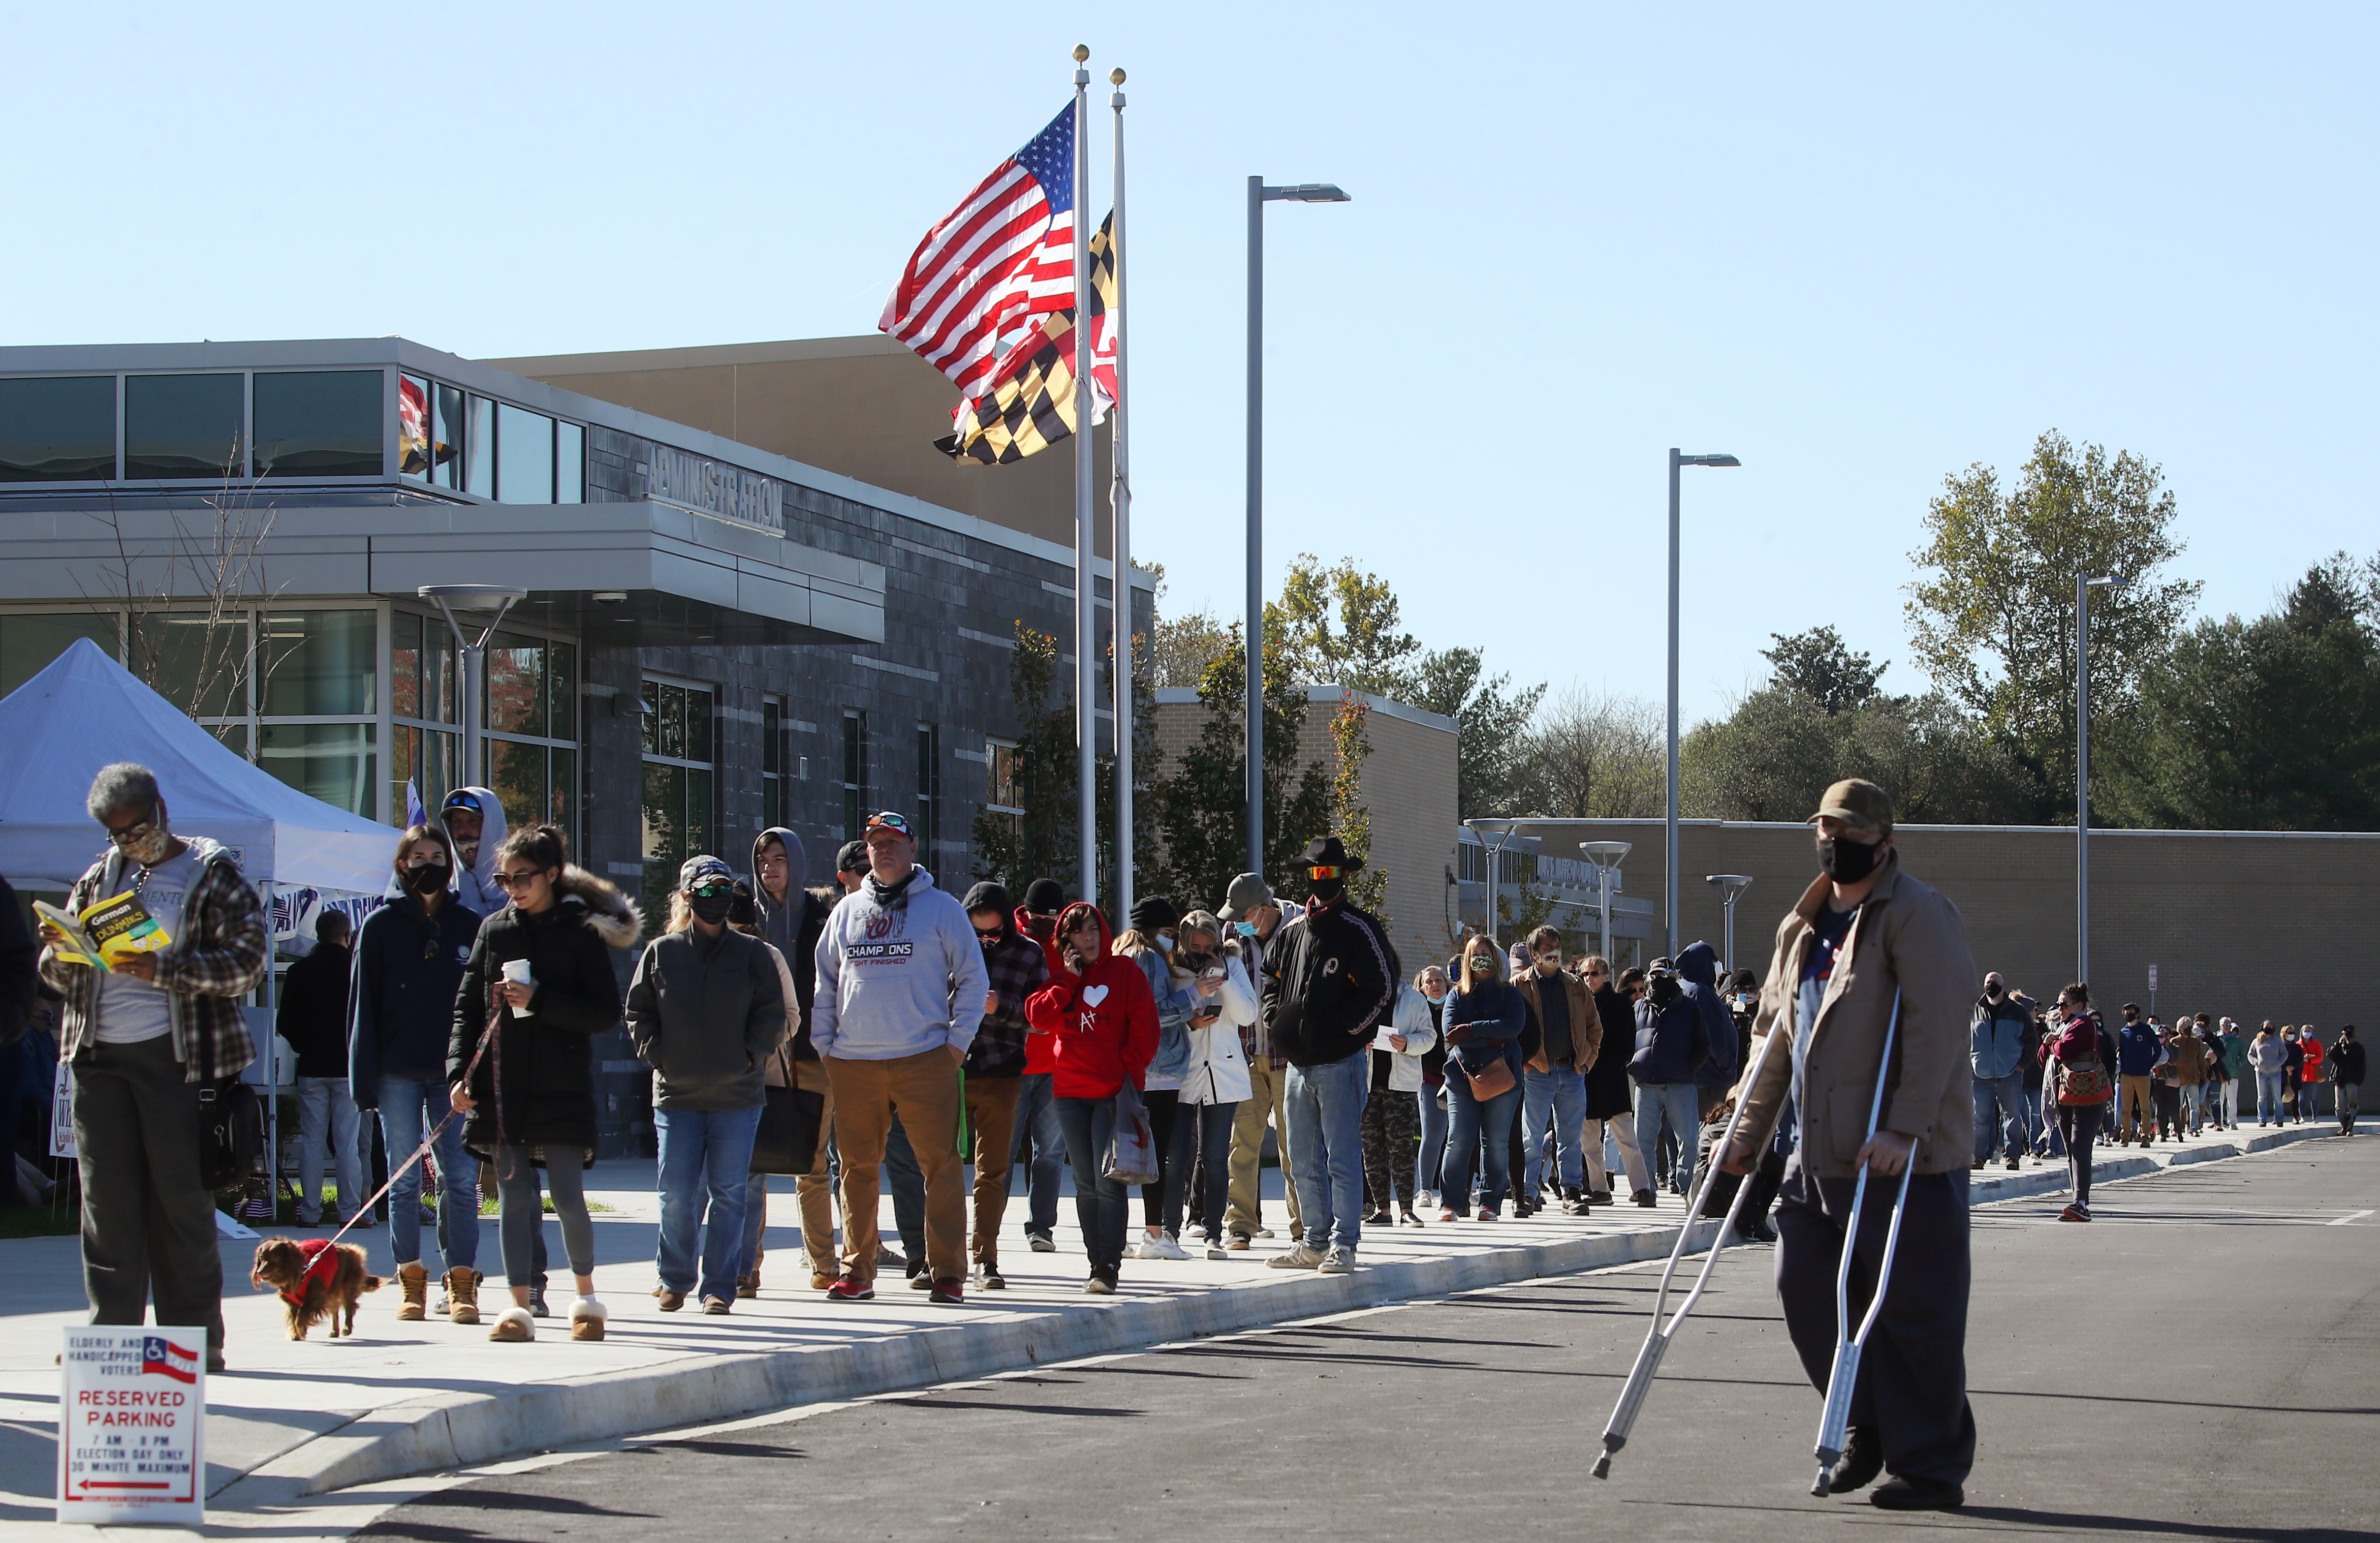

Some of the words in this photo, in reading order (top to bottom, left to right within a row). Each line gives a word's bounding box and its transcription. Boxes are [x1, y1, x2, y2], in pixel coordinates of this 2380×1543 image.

[646, 444, 782, 529] ADMINISTRATION
[91, 904, 132, 926] German
[96, 911, 144, 940] DUMMIES
[59, 1131, 71, 1143] School
[70, 1337, 113, 1348] ELDERLY
[120, 1339, 142, 1348] AND
[68, 1351, 142, 1362] HANDICAPPED
[100, 1365, 141, 1375] VOTERS
[79, 1391, 184, 1406] RESERVED
[87, 1412, 175, 1427] PARKING
[93, 1435, 99, 1445] 7
[106, 1435, 122, 1445] AM
[140, 1436, 147, 1445] 8
[153, 1436, 170, 1446] PM
[77, 1449, 126, 1460] ELECTION
[132, 1450, 151, 1460] DAY
[159, 1450, 184, 1460] ONLY
[71, 1462, 84, 1472] 30
[91, 1462, 130, 1473] MINUTE
[137, 1463, 190, 1474] MAXIMUM
